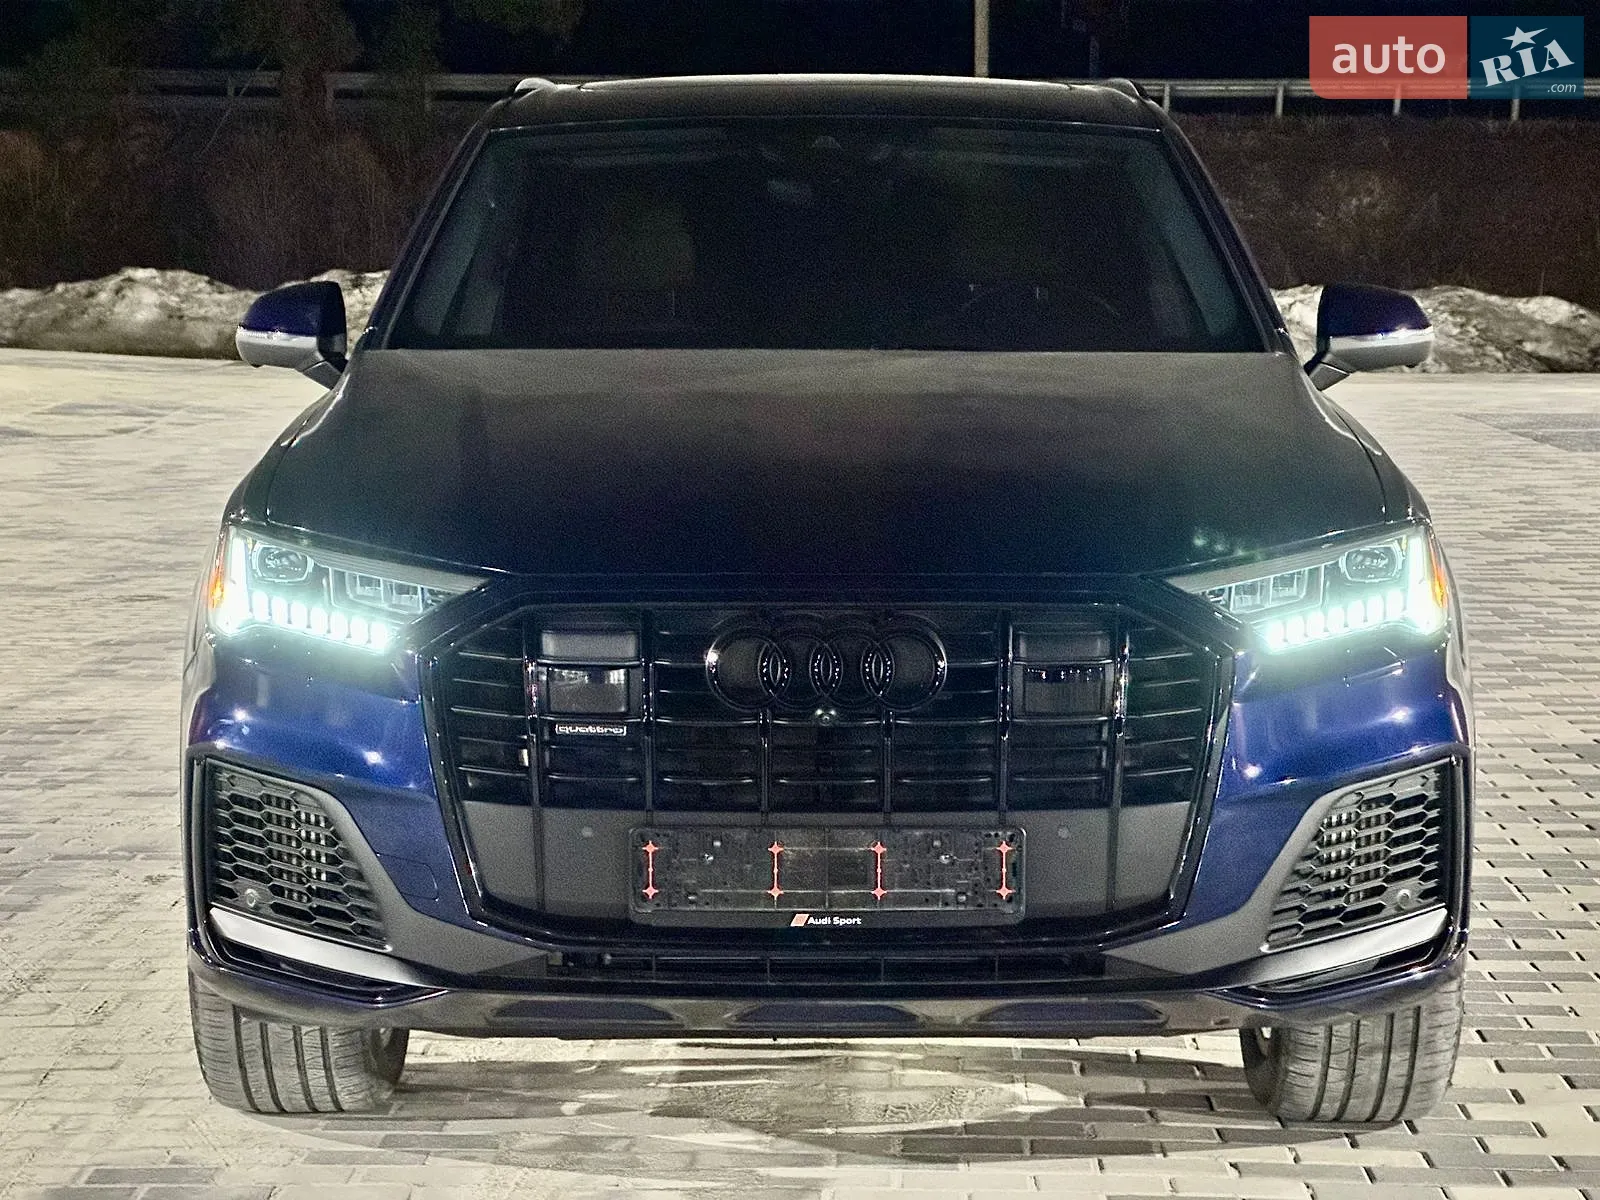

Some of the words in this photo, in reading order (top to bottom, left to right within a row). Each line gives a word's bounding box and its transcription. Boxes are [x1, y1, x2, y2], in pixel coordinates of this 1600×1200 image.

[558, 725, 625, 735] quattro
[807, 916, 831, 925] Audi
[833, 916, 862, 926] Sport
